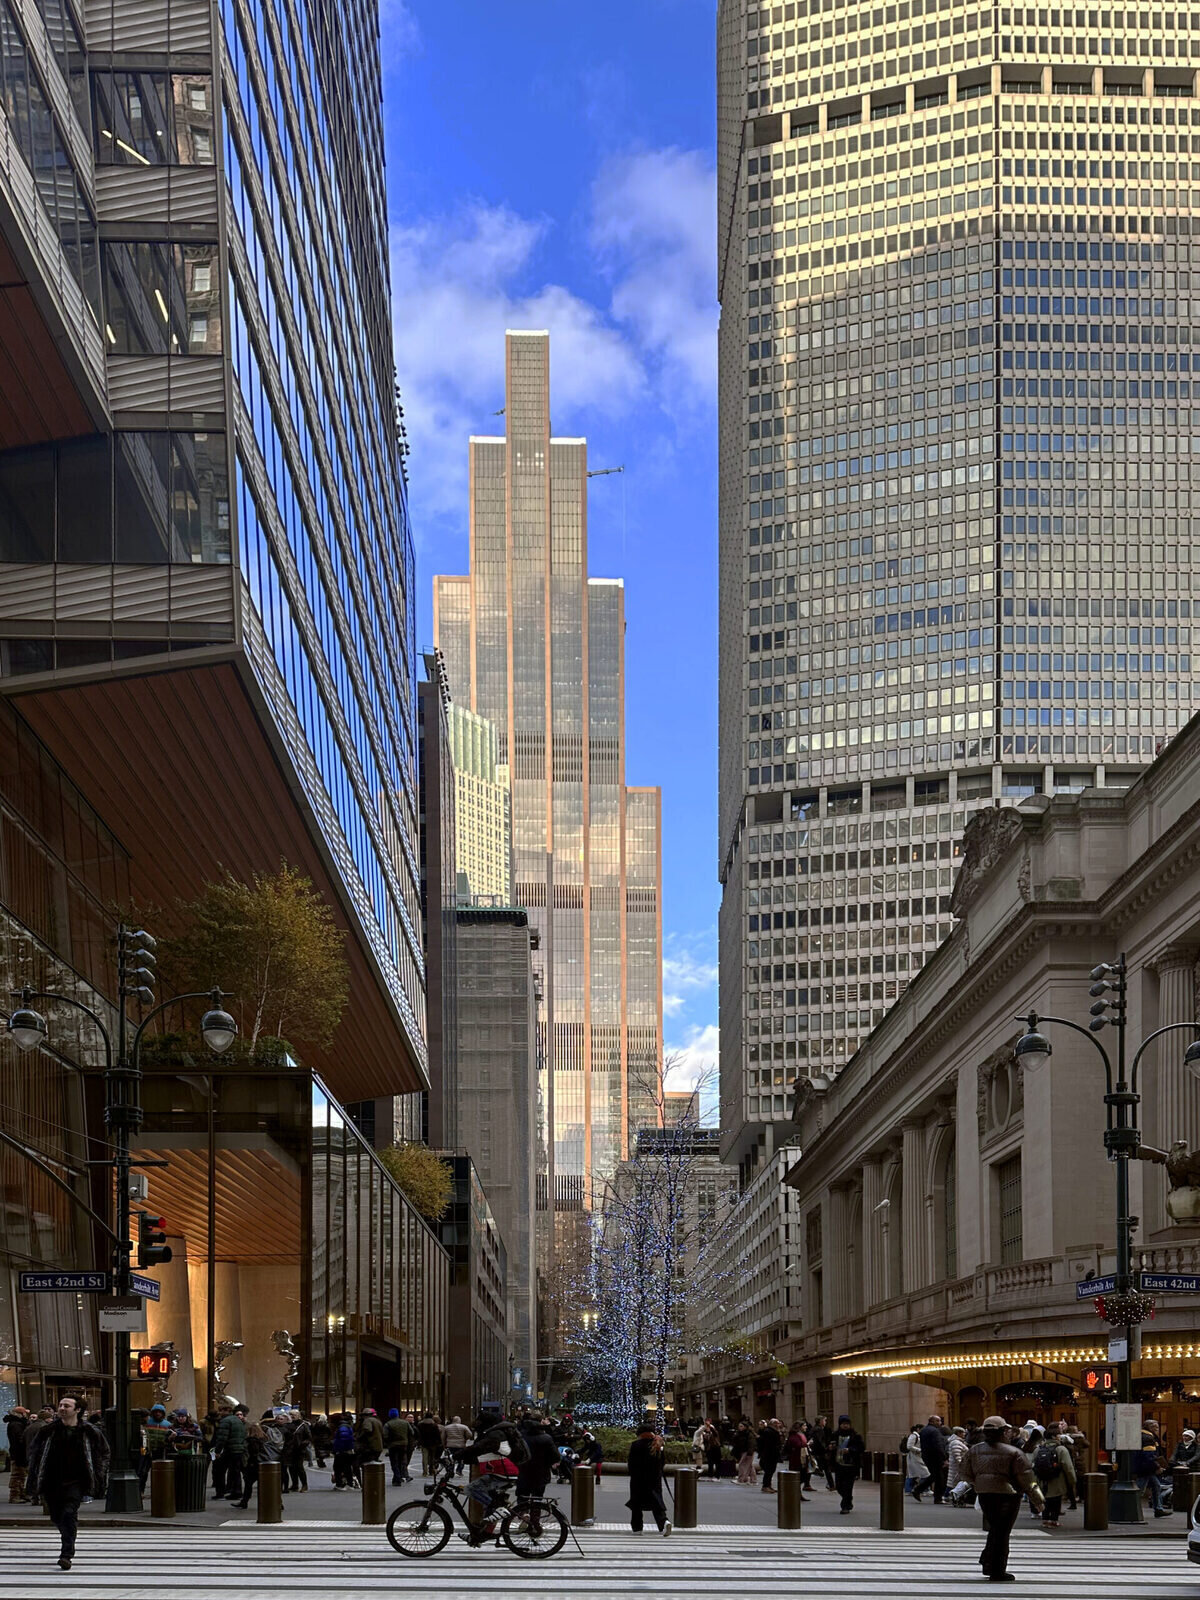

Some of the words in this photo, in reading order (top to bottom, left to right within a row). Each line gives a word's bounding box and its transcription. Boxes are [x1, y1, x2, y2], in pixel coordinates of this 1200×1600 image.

[26, 1277, 52, 1287] East
[55, 1277, 85, 1287] 42nd
[88, 1276, 102, 1287] St
[134, 1281, 151, 1293] anderbilt
[1144, 1277, 1168, 1288] East
[1170, 1279, 1196, 1289] 42nd
[160, 1357, 168, 1373] 0
[1104, 1373, 1112, 1389] 0
